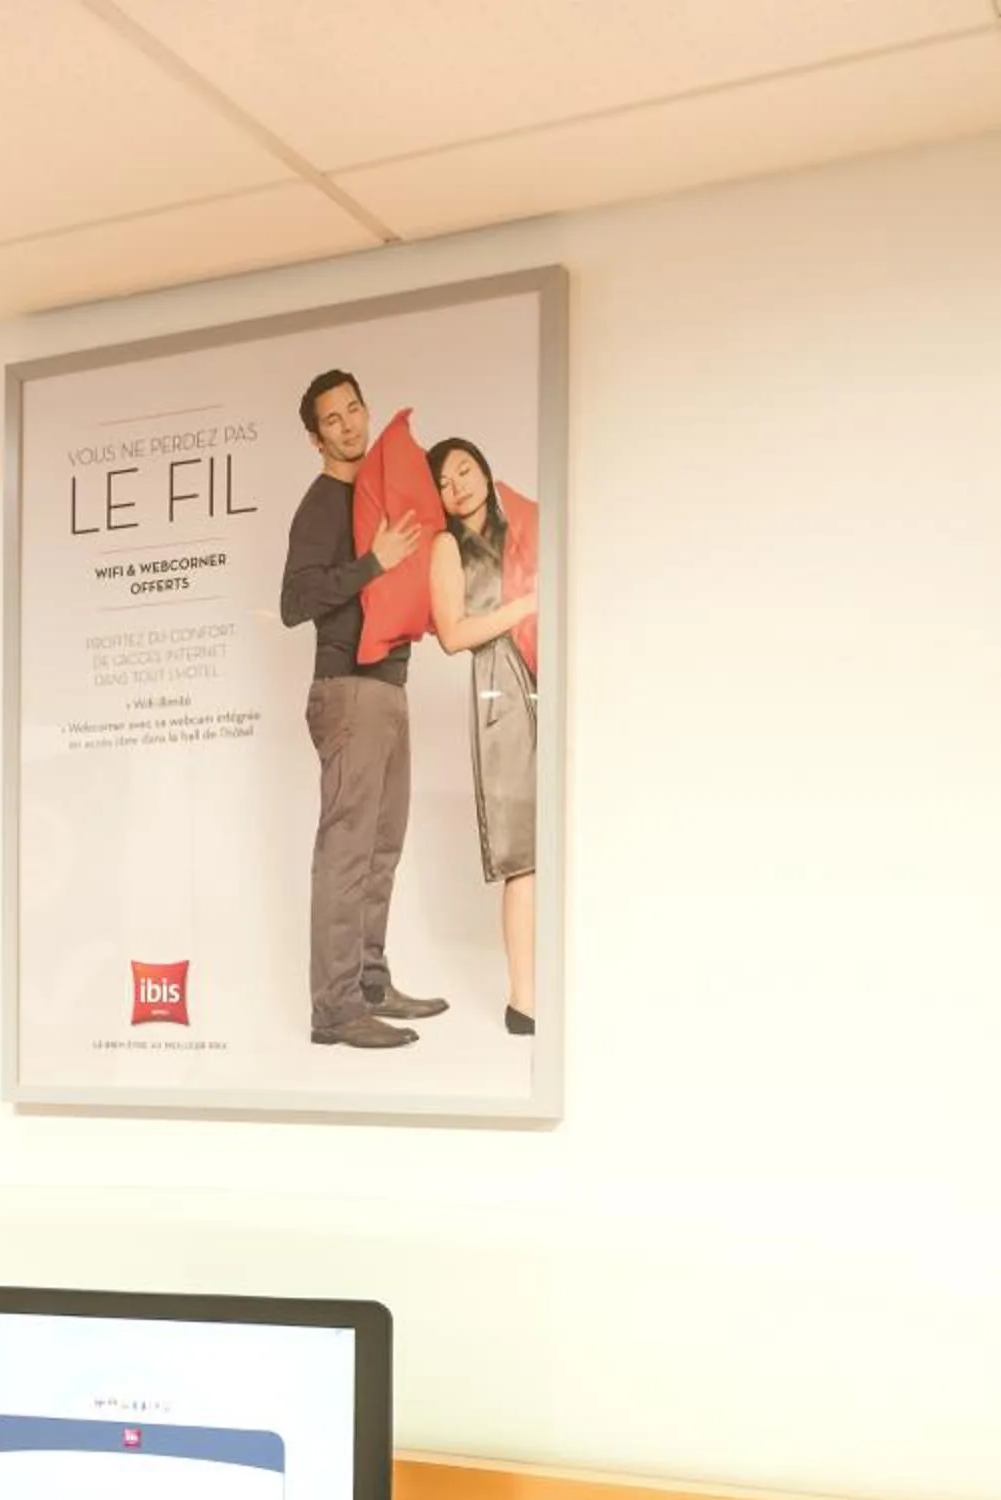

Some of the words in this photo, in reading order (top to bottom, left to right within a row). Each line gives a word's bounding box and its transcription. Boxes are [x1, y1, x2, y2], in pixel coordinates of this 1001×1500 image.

[68, 444, 116, 467] VOUS
[121, 438, 146, 459] NE
[150, 428, 219, 455] PERDEZ
[224, 422, 259, 443] PAS
[71, 467, 139, 535] LE
[169, 454, 258, 523] FIL
[95, 563, 125, 580] WIFI
[126, 562, 136, 577] &
[139, 552, 227, 576] WEBCORNER
[130, 576, 191, 595] OFFERTS
[148, 630, 167, 646] DU
[170, 624, 236, 643] CONFORT
[139, 976, 181, 1004] ibis
